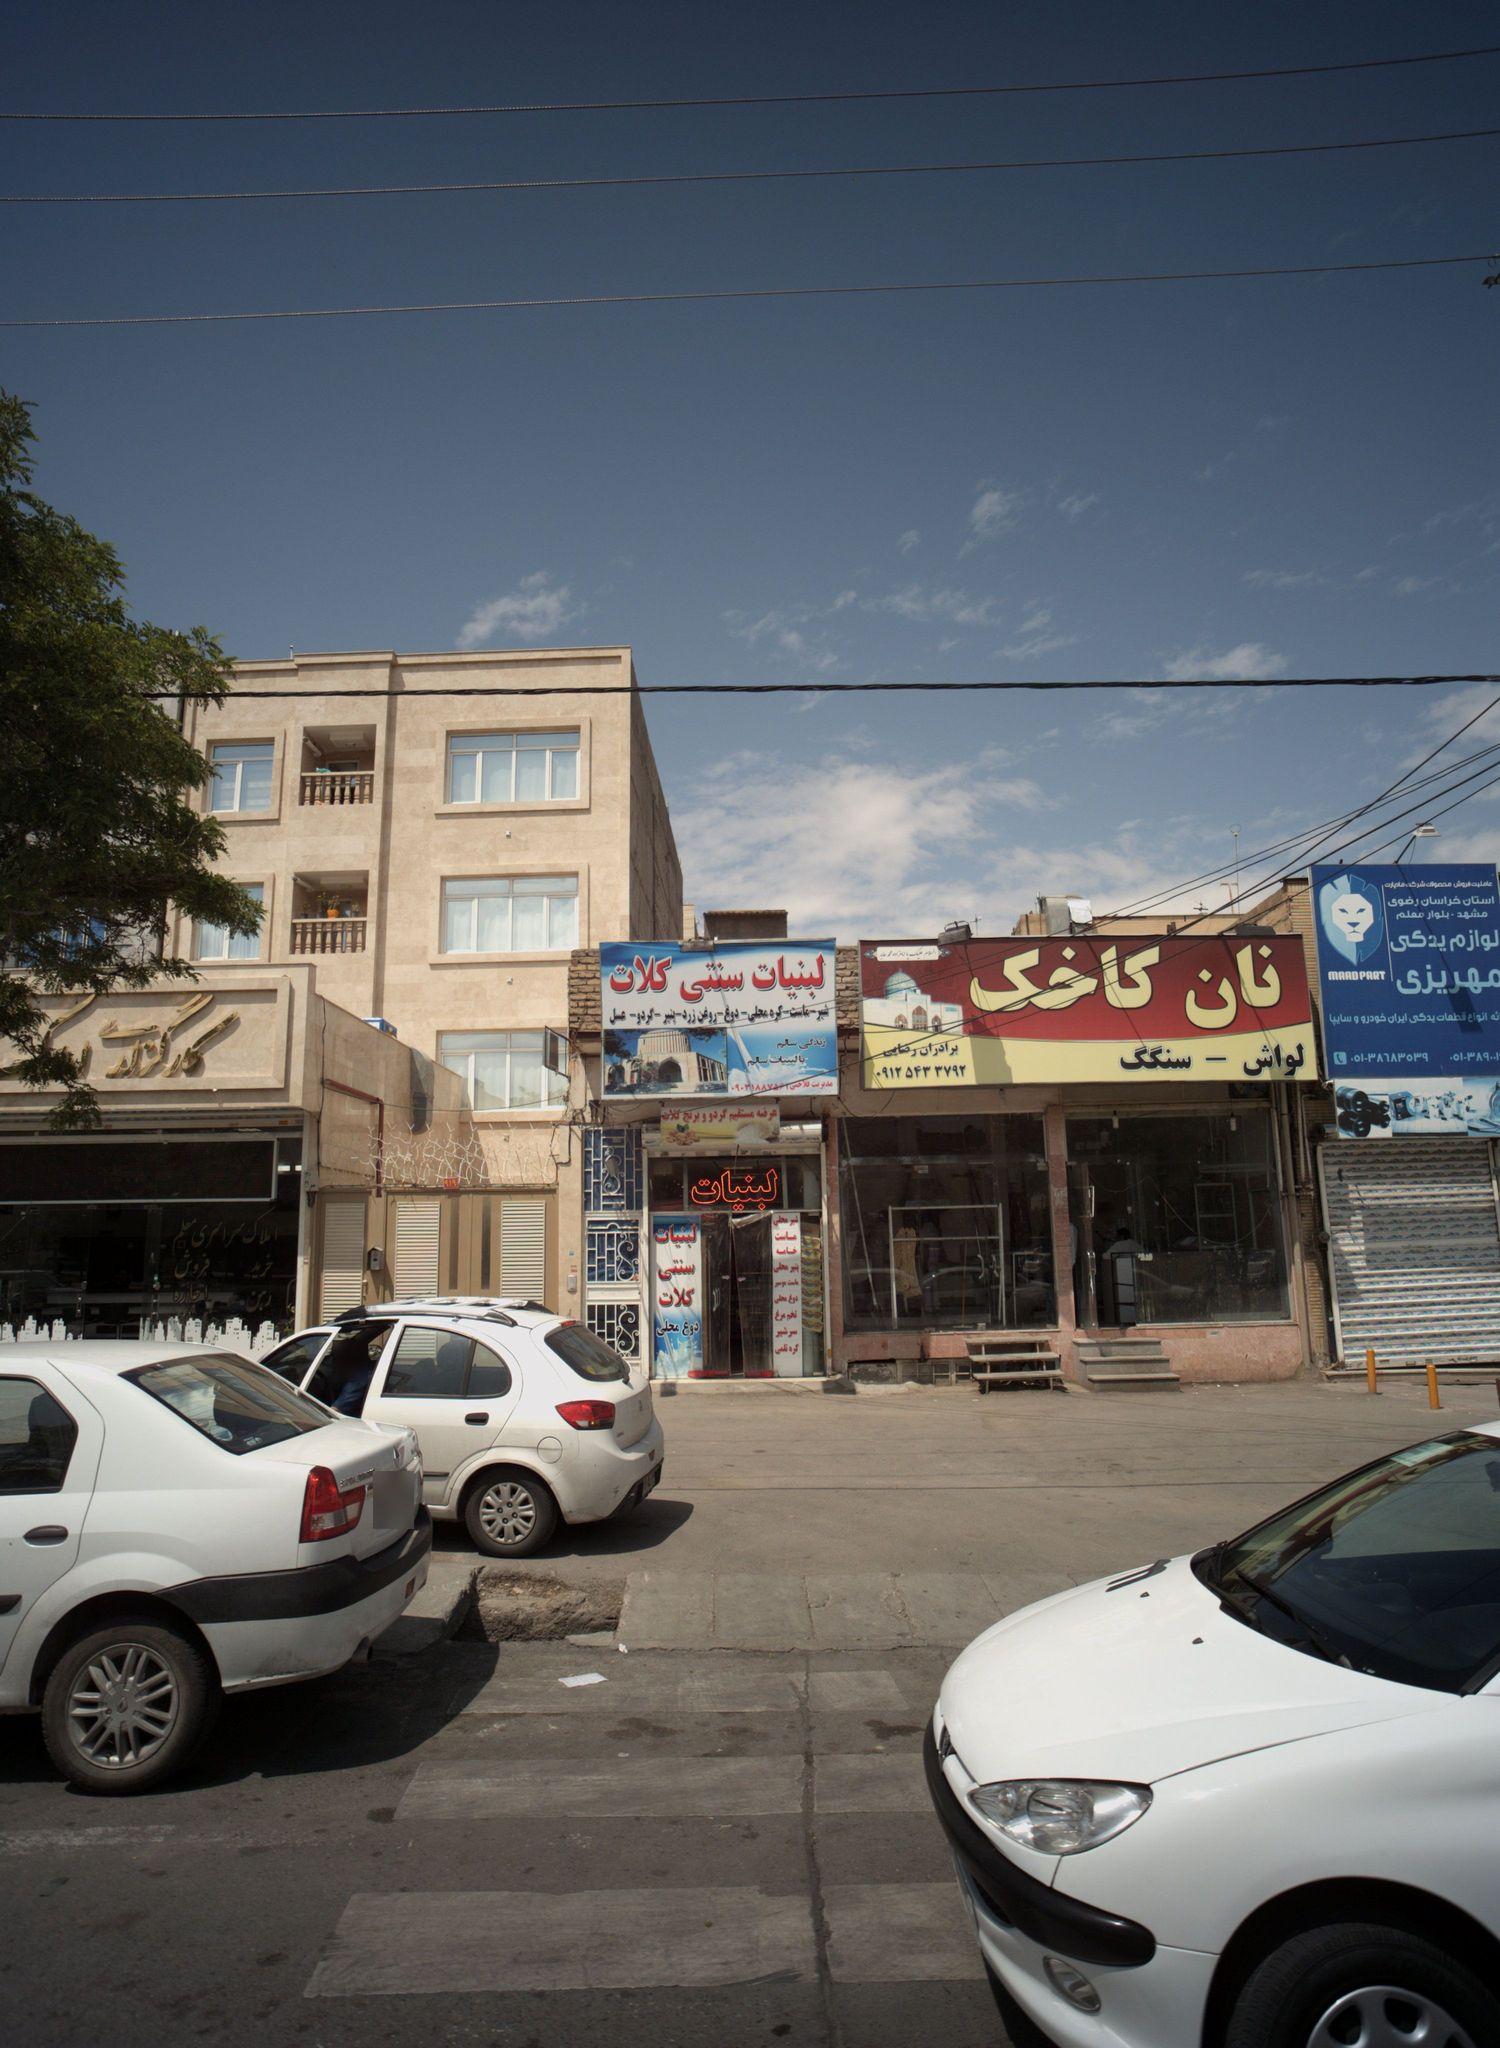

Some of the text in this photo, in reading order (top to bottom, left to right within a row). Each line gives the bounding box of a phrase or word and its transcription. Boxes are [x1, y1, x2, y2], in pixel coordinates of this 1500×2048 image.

[1387, 895, 1495, 907] استان خراسان رضوی
[1396, 908, 1488, 920] مشهد بلوار معلم
[1390, 929, 1499, 952] لوازم یدکی
[609, 952, 826, 1002] لبنیات سنتی کلات
[1396, 964, 1500, 994] مهریزی
[969, 944, 1282, 1030] نان کاخک
[609, 1008, 626, 1025] عسل
[636, 1007, 654, 1026] گردو
[682, 1008, 696, 1024] زرد
[697, 1006, 717, 1024] روغن
[724, 1004, 739, 1023] دوغ
[747, 1005, 768, 1023] محلی
[790, 1003, 809, 1018] ماست
[816, 1004, 829, 1022] شیر
[1387, 1012, 1408, 1023] ایران
[1409, 1013, 1436, 1023] یدکی
[1437, 1012, 1466, 1023] قطعات
[1468, 1012, 1488, 1023] انواع
[1329, 1013, 1352, 1026] سایپا
[1360, 1013, 1386, 1024] خودرو
[777, 1038, 798, 1050] سالم
[920, 1041, 959, 1056] برادران
[747, 1056, 768, 1067] سالم
[1243, 1043, 1305, 1076] لواش
[876, 1064, 967, 1079] ۰۹۱۲ ۵۴۳ ۳۷۹۲
[683, 1110, 700, 1123] برنج
[708, 1108, 728, 1122] گردو
[729, 1107, 755, 1120] مستقیم
[757, 1107, 778, 1121] عرضه
[690, 1167, 779, 1211] لبنیات
[773, 1215, 788, 1227] محلی
[655, 1223, 698, 1249] لبنیات
[774, 1230, 797, 1241] ماست
[657, 1259, 696, 1281] سنتی
[773, 1262, 788, 1273] محلی
[658, 1287, 696, 1308] کلات
[773, 1295, 788, 1304] محلی
[656, 1320, 680, 1337] محلی
